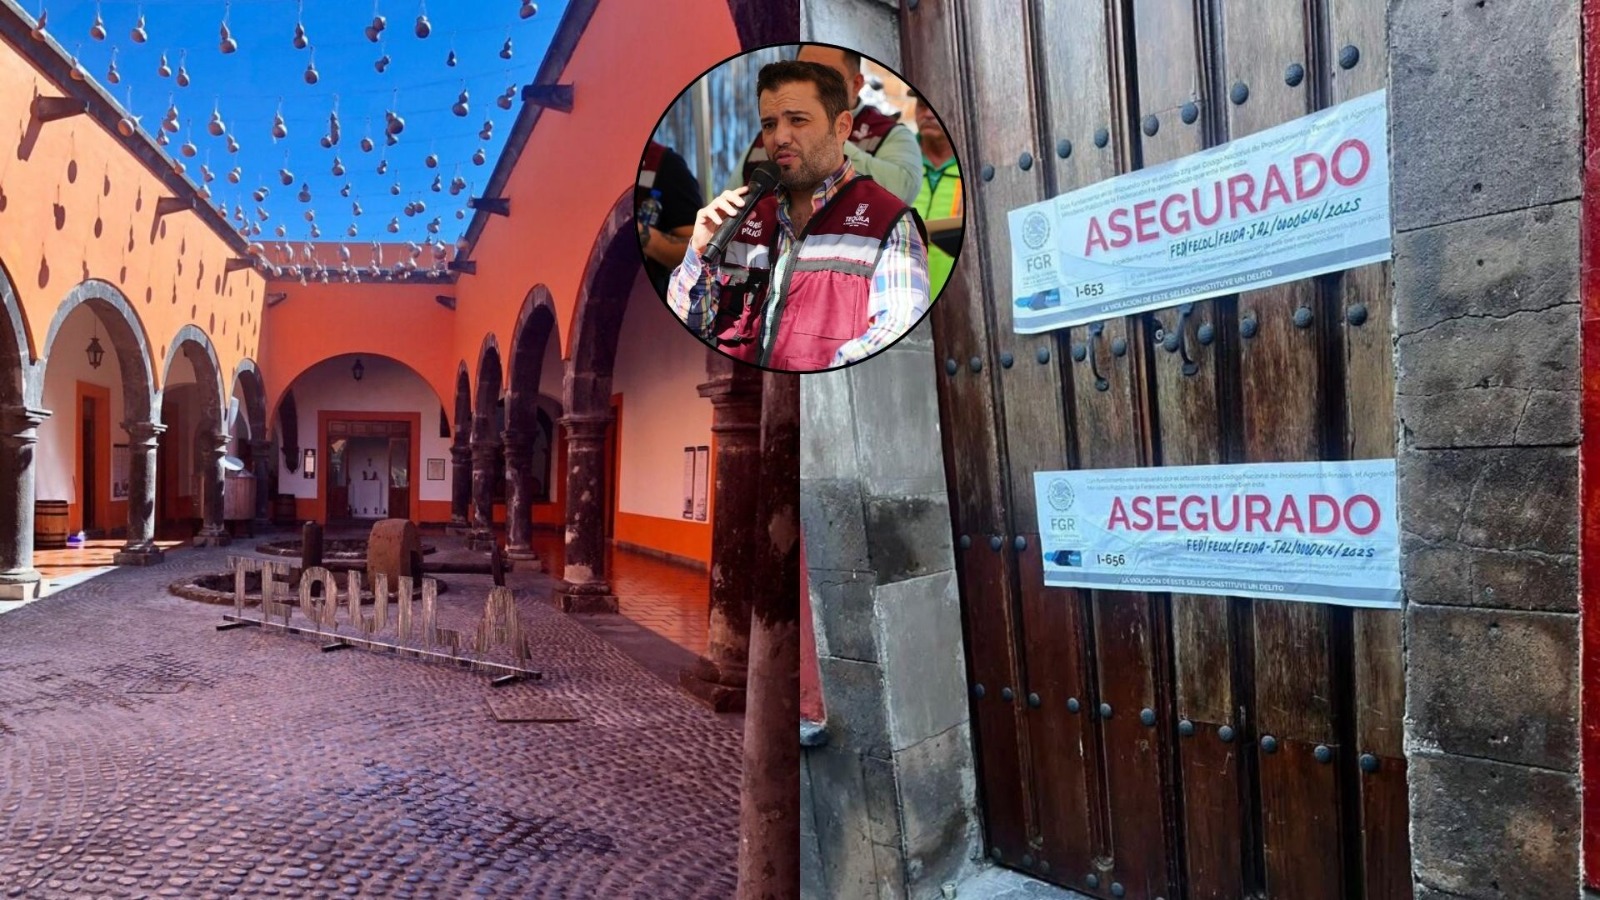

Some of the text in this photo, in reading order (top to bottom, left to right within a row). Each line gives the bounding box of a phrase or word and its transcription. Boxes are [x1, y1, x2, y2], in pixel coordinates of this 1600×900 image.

[1084, 139, 1370, 256] ASEGURADO
[845, 215, 870, 224] TEQUILA
[1026, 252, 1051, 272] FGR
[1234, 274, 1245, 284] UN
[1246, 268, 1272, 282] DELITO
[1075, 280, 1104, 299] I-653
[1107, 494, 1380, 535] ASEGURADO
[1050, 518, 1075, 530] FGR
[1096, 553, 1125, 566] I-656
[1259, 583, 1283, 591] DELITO
[226, 556, 531, 660] TEQUILA
